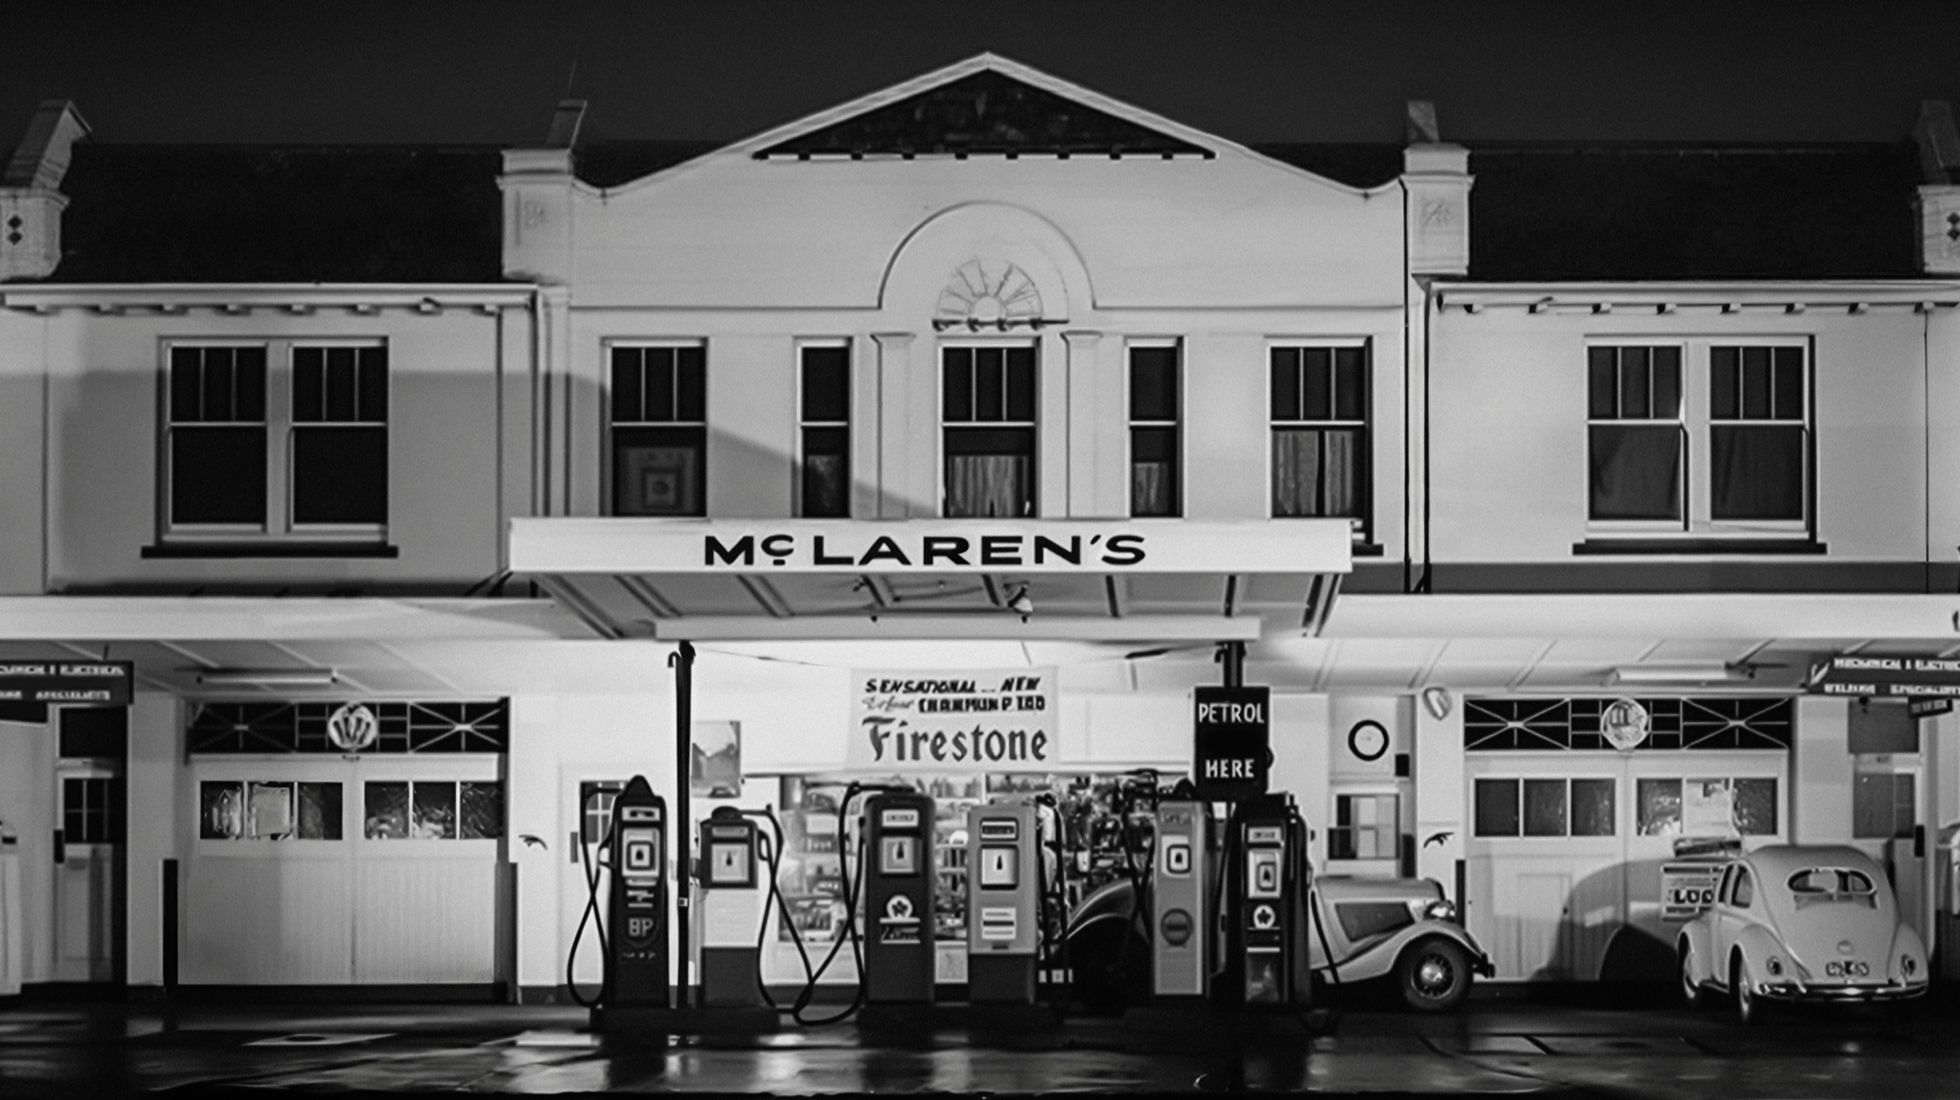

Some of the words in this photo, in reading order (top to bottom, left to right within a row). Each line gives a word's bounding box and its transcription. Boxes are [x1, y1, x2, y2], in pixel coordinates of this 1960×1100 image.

[865, 679, 976, 694] SENSATIONAL
[1000, 676, 1041, 692] NEW
[1198, 702, 1264, 723] PETROL
[862, 716, 1047, 762] Firestone
[1205, 759, 1254, 778] HERE
[628, 917, 654, 937] BP
